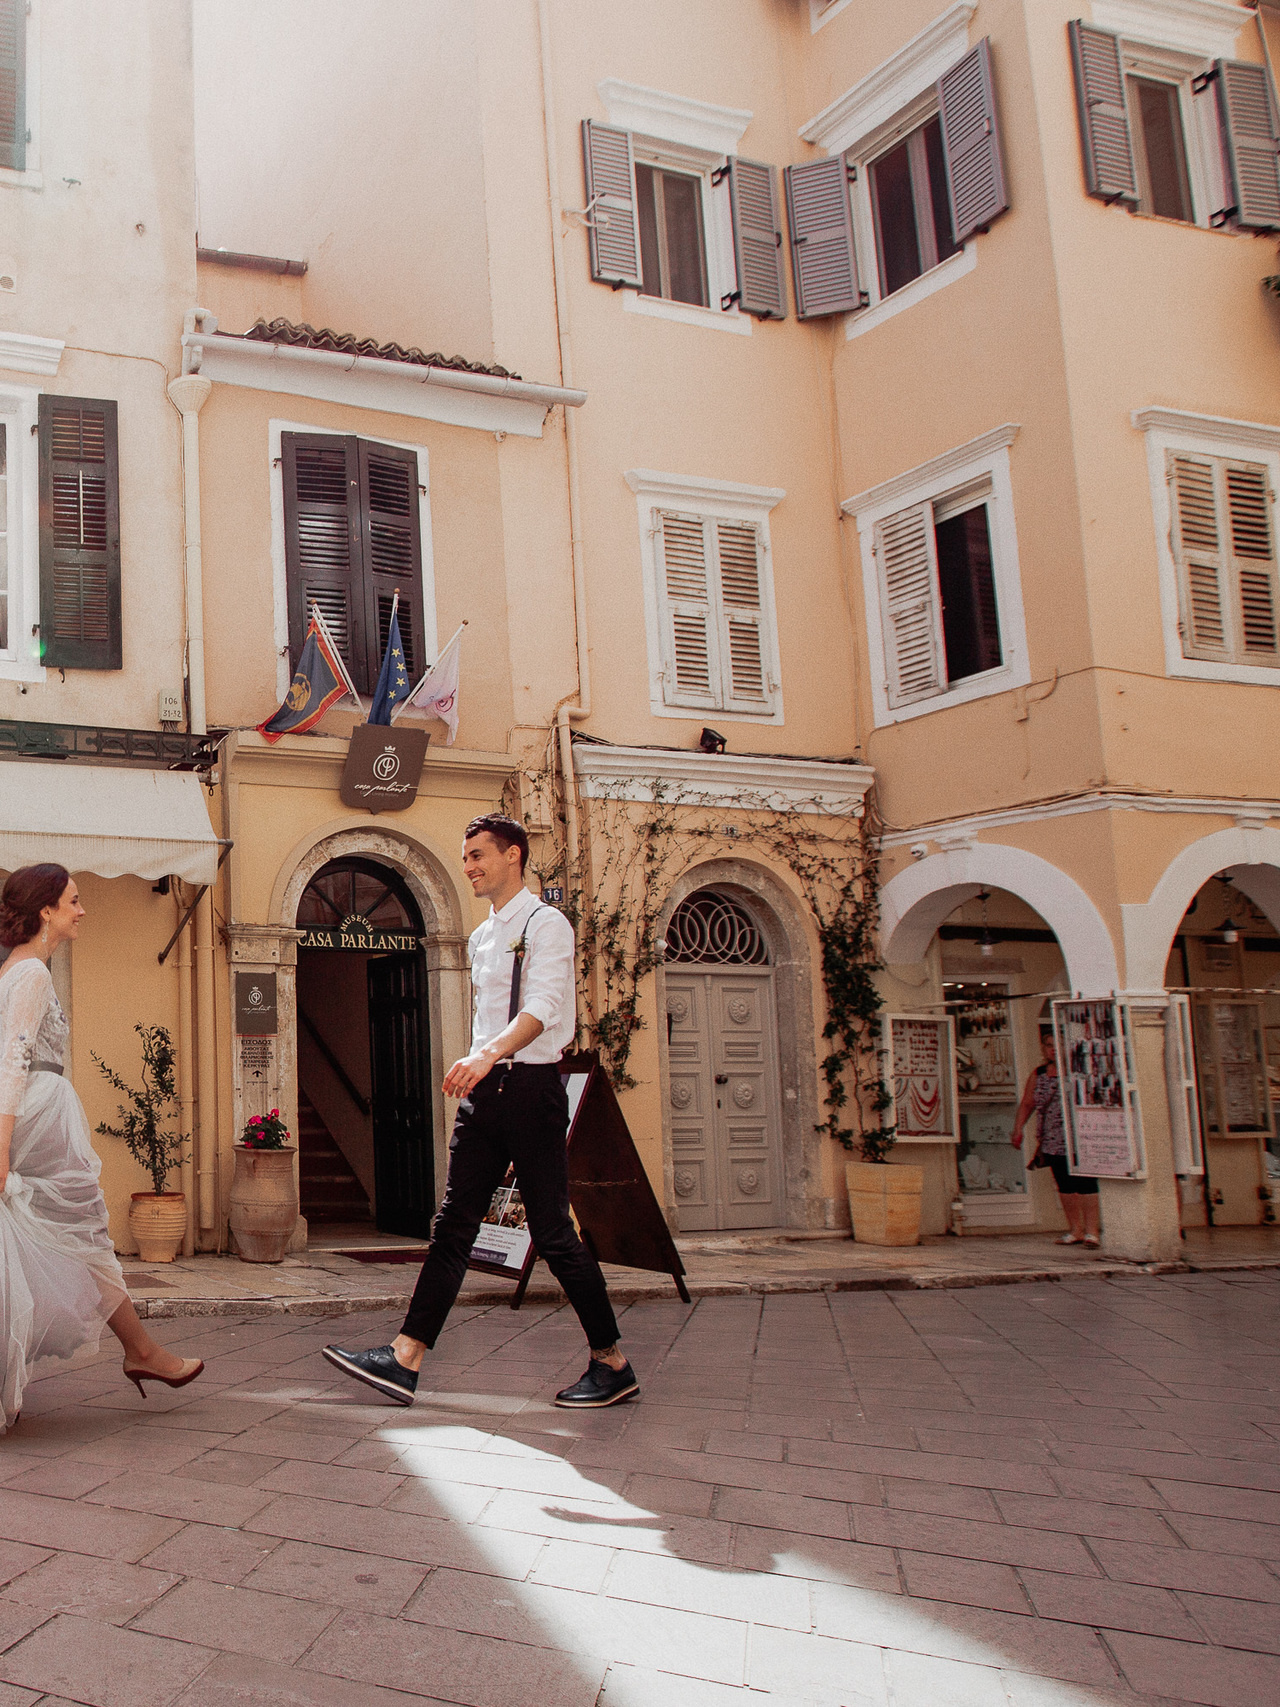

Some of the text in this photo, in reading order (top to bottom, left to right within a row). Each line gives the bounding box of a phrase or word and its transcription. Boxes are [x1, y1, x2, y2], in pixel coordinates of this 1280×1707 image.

[164, 696, 178, 705] 106
[547, 888, 560, 901] 16
[340, 914, 374, 933] MUSEUM
[297, 932, 417, 950] CASA PARLANTE
